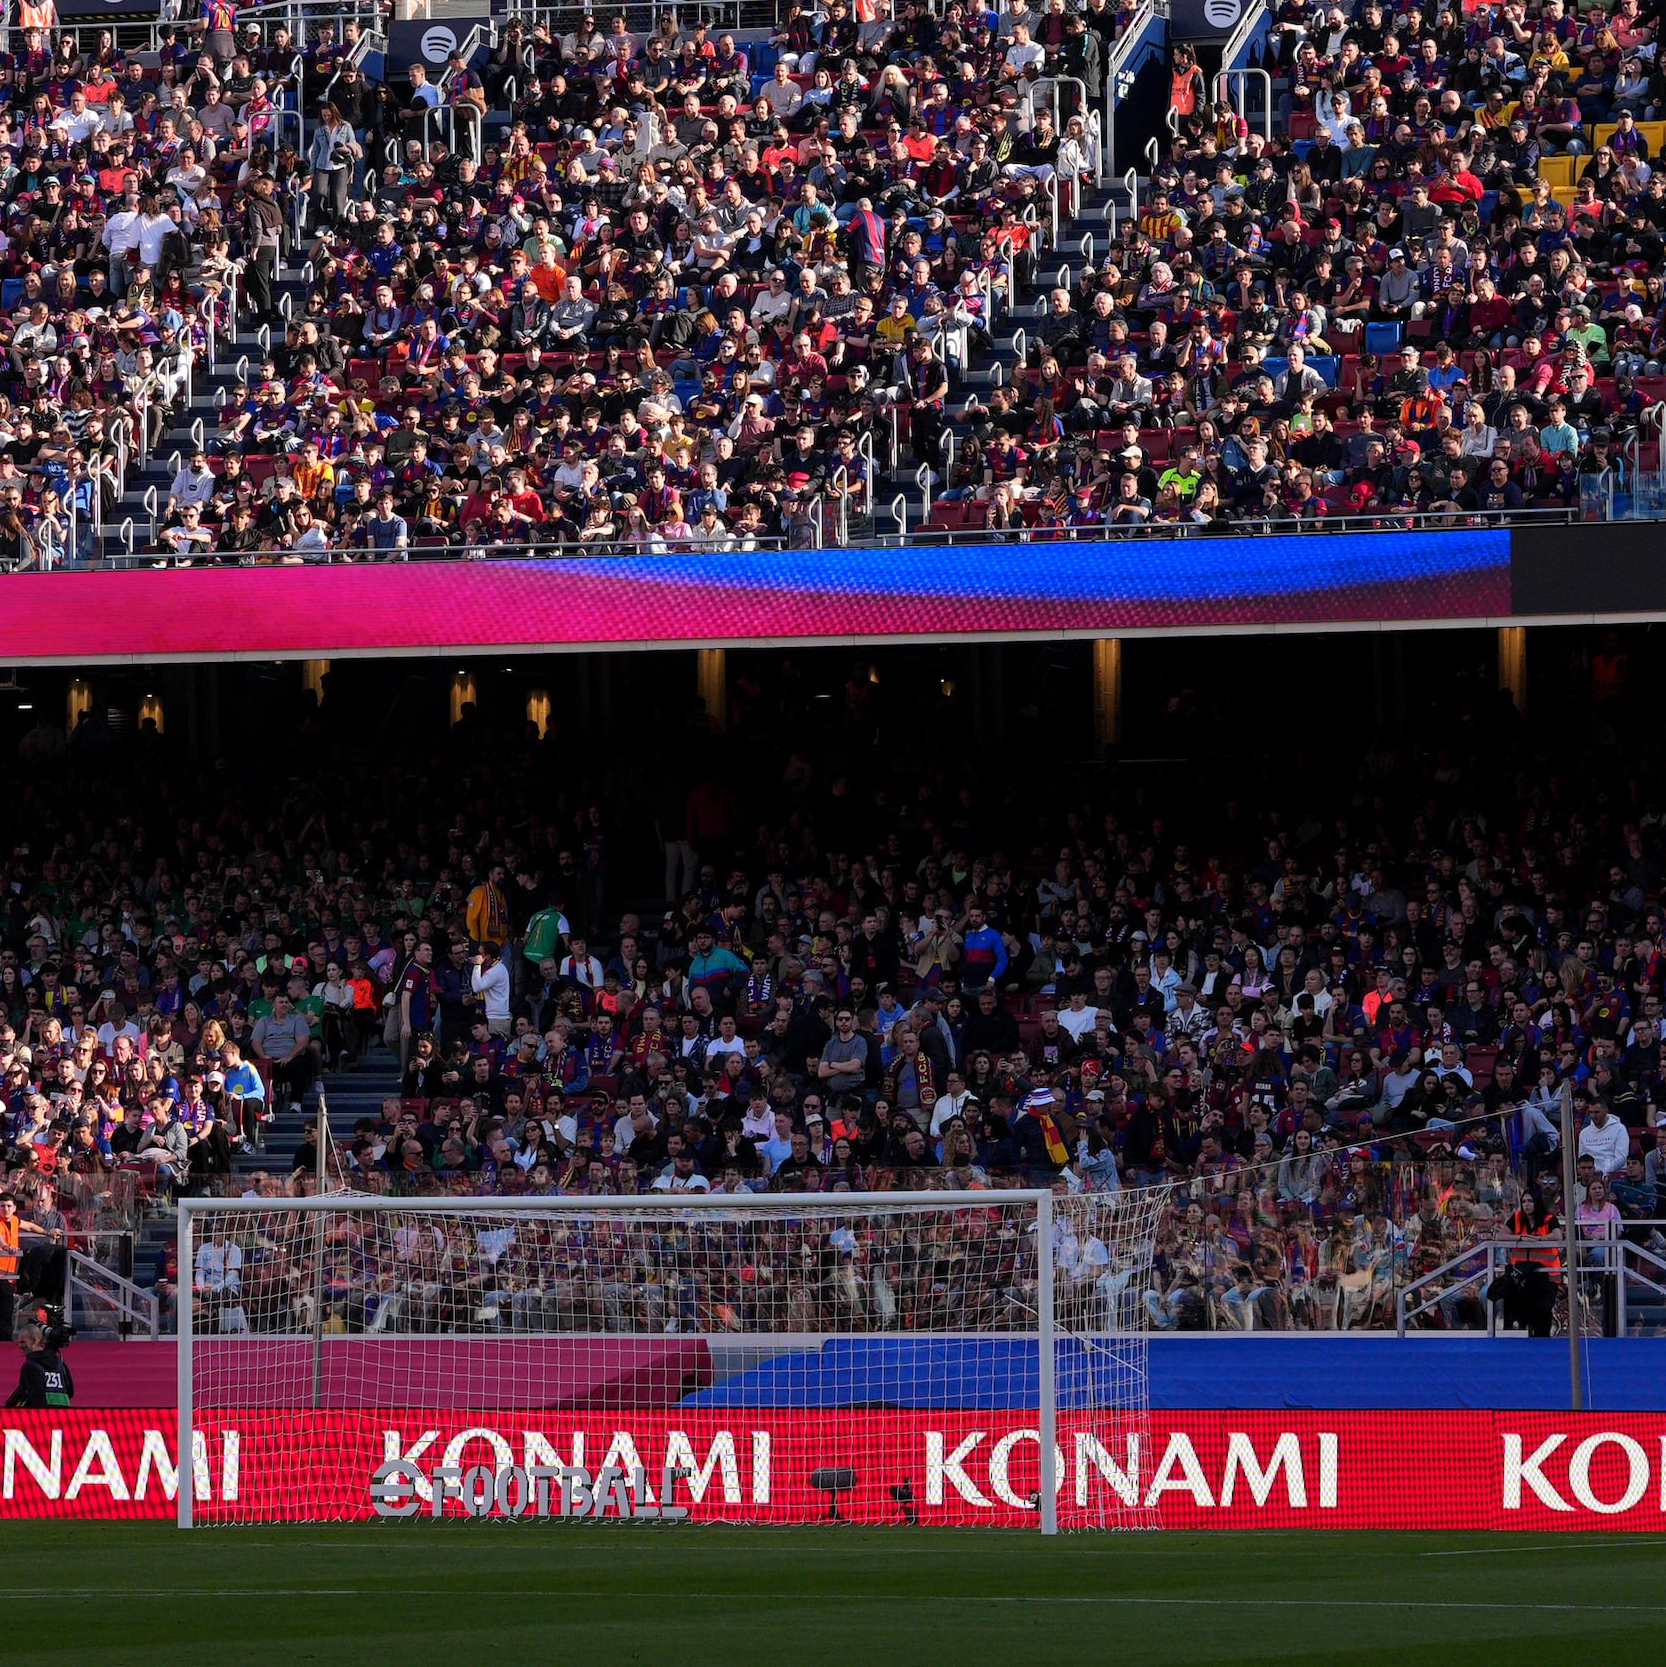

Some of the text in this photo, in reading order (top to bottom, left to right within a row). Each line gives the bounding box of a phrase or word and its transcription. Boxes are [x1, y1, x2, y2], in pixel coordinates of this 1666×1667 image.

[44, 1371, 64, 1389] 231
[382, 1428, 770, 1506] KONAMI
[924, 1429, 1339, 1511] KONAMI
